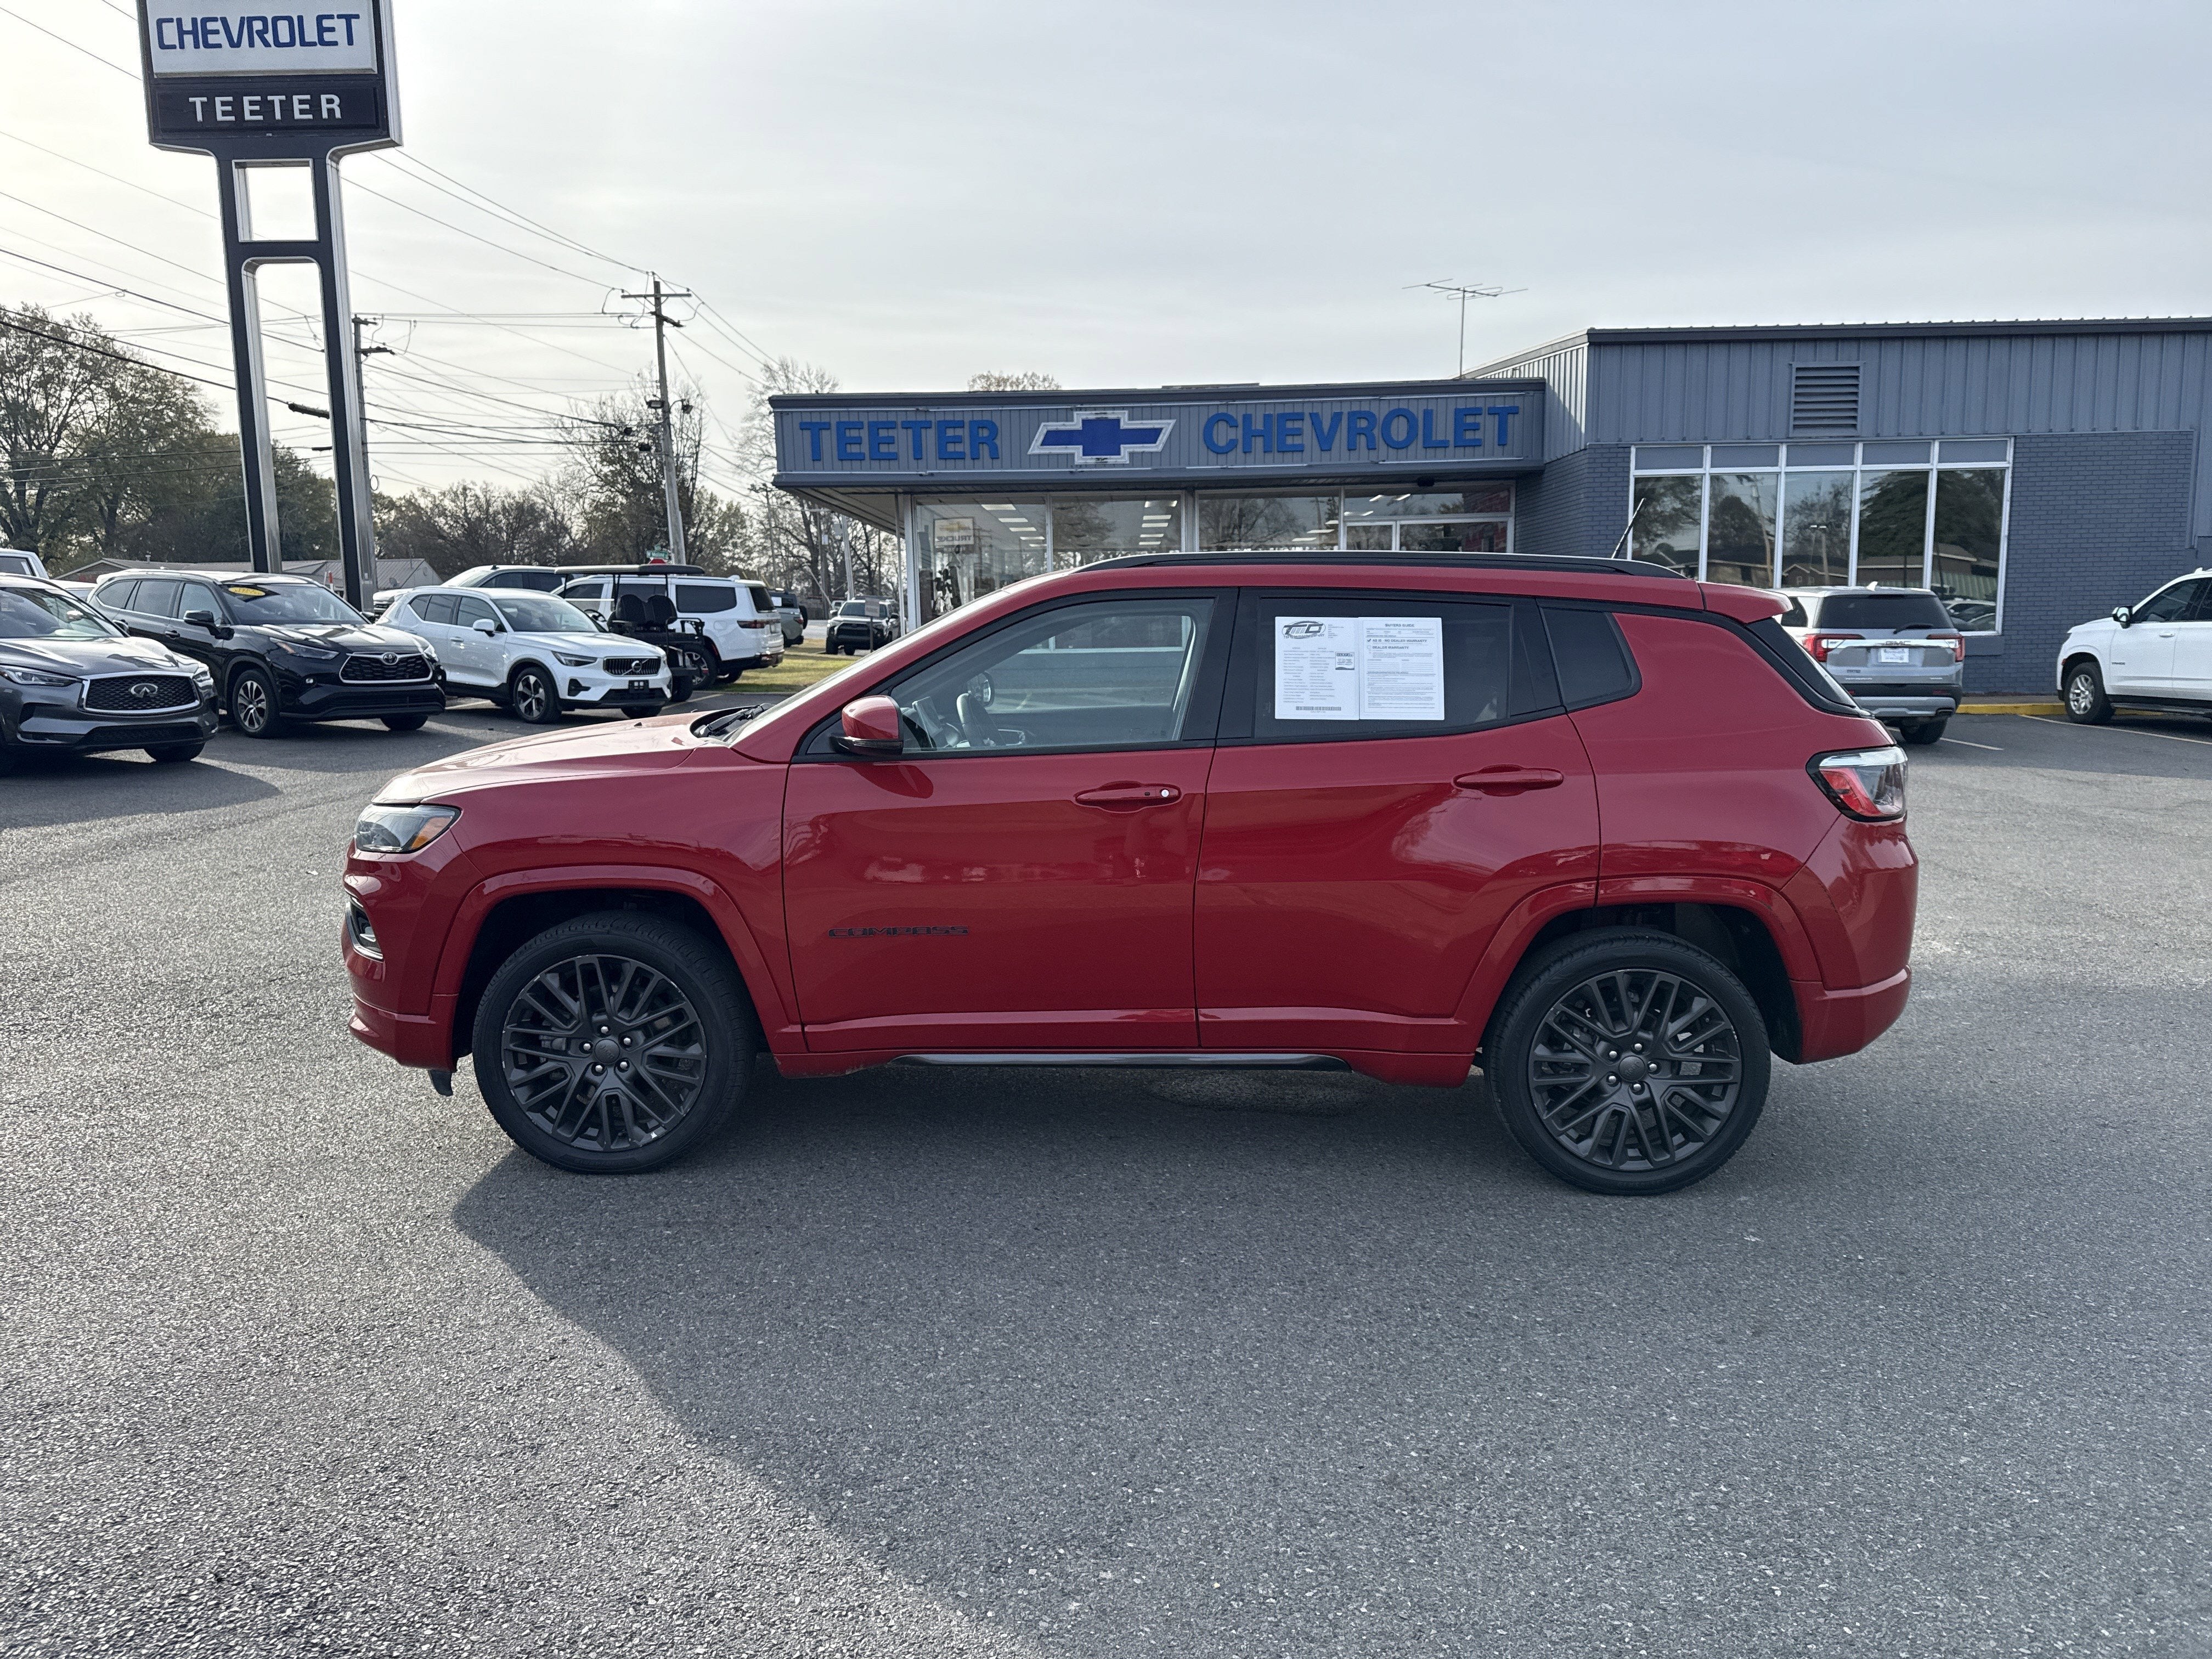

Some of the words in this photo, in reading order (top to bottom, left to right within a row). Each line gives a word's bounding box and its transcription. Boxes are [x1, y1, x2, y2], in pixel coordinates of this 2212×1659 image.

[156, 14, 360, 50] CHEVROLET
[189, 94, 343, 122] TEETER
[799, 419, 1000, 461] TEETER
[1203, 405, 1519, 455] CHEVROLET
[828, 926, 969, 938] COMPASS
